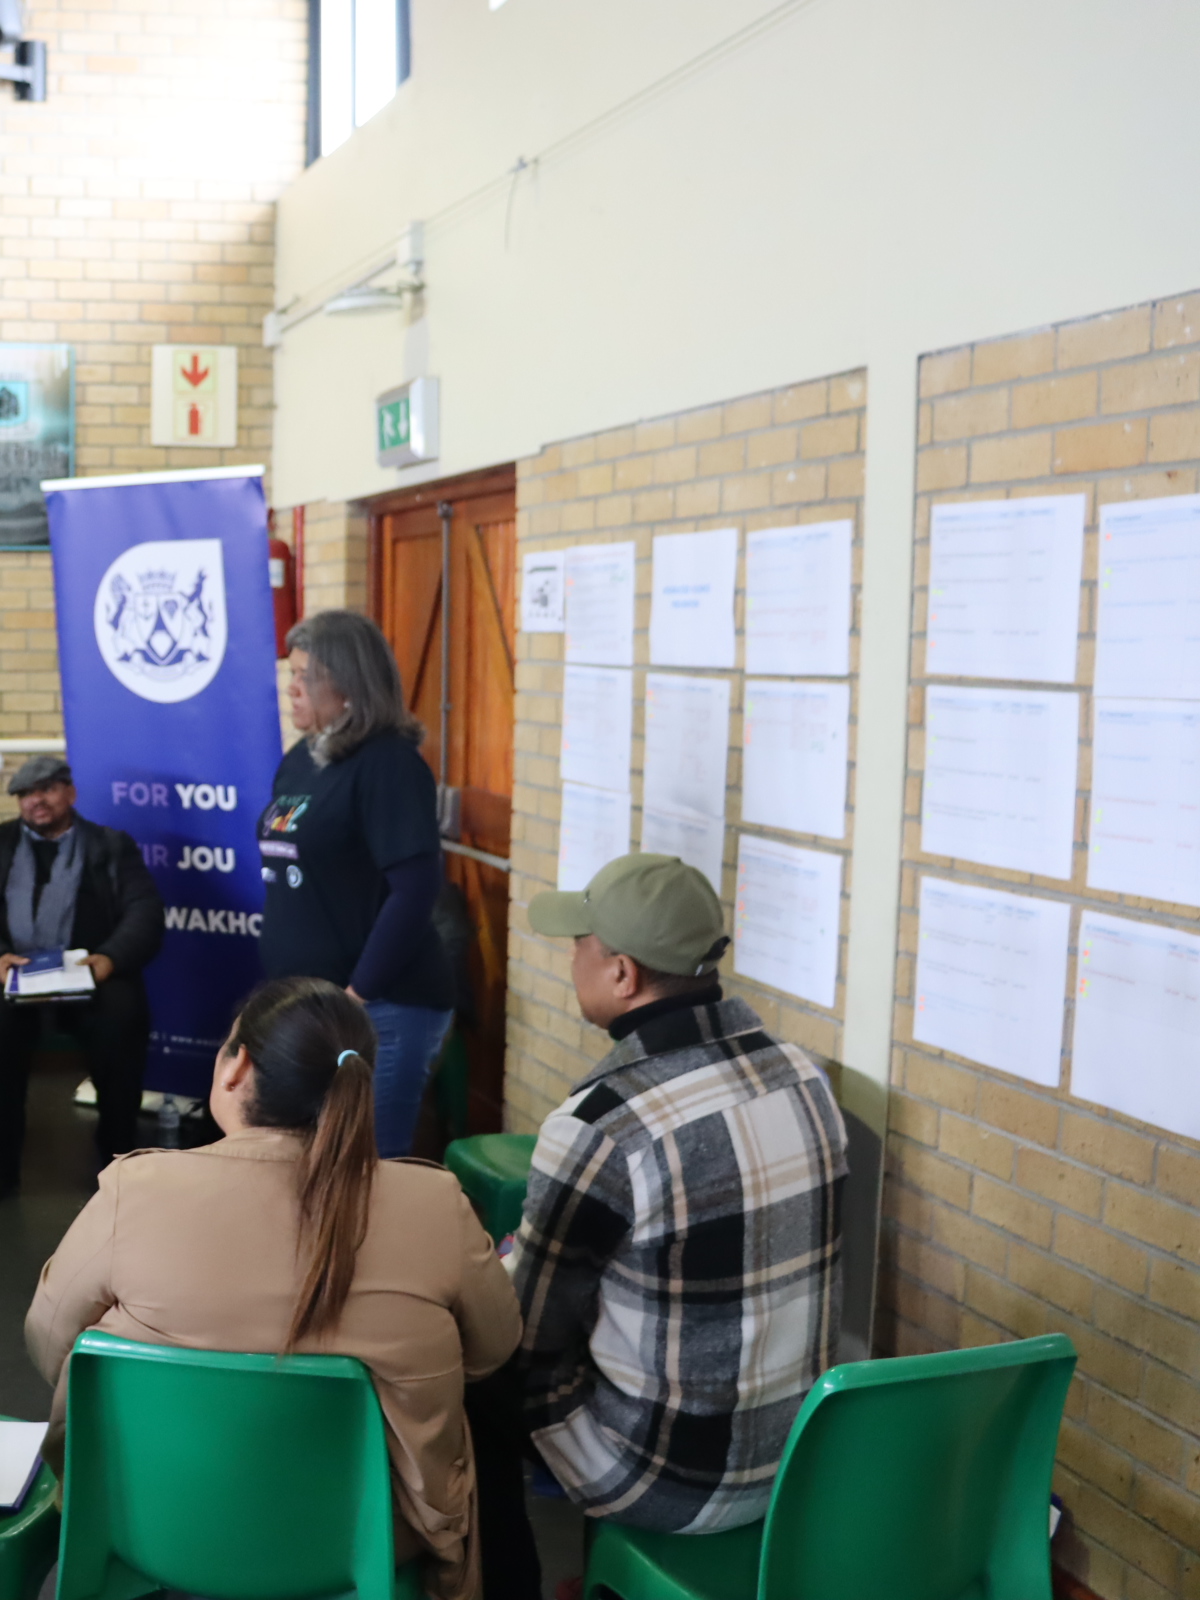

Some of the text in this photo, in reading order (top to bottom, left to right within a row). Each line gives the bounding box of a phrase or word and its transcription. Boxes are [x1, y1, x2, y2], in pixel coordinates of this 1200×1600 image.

[111, 781, 237, 811] FOR YOU
[136, 842, 169, 867] IR
[177, 845, 236, 873] JOU
